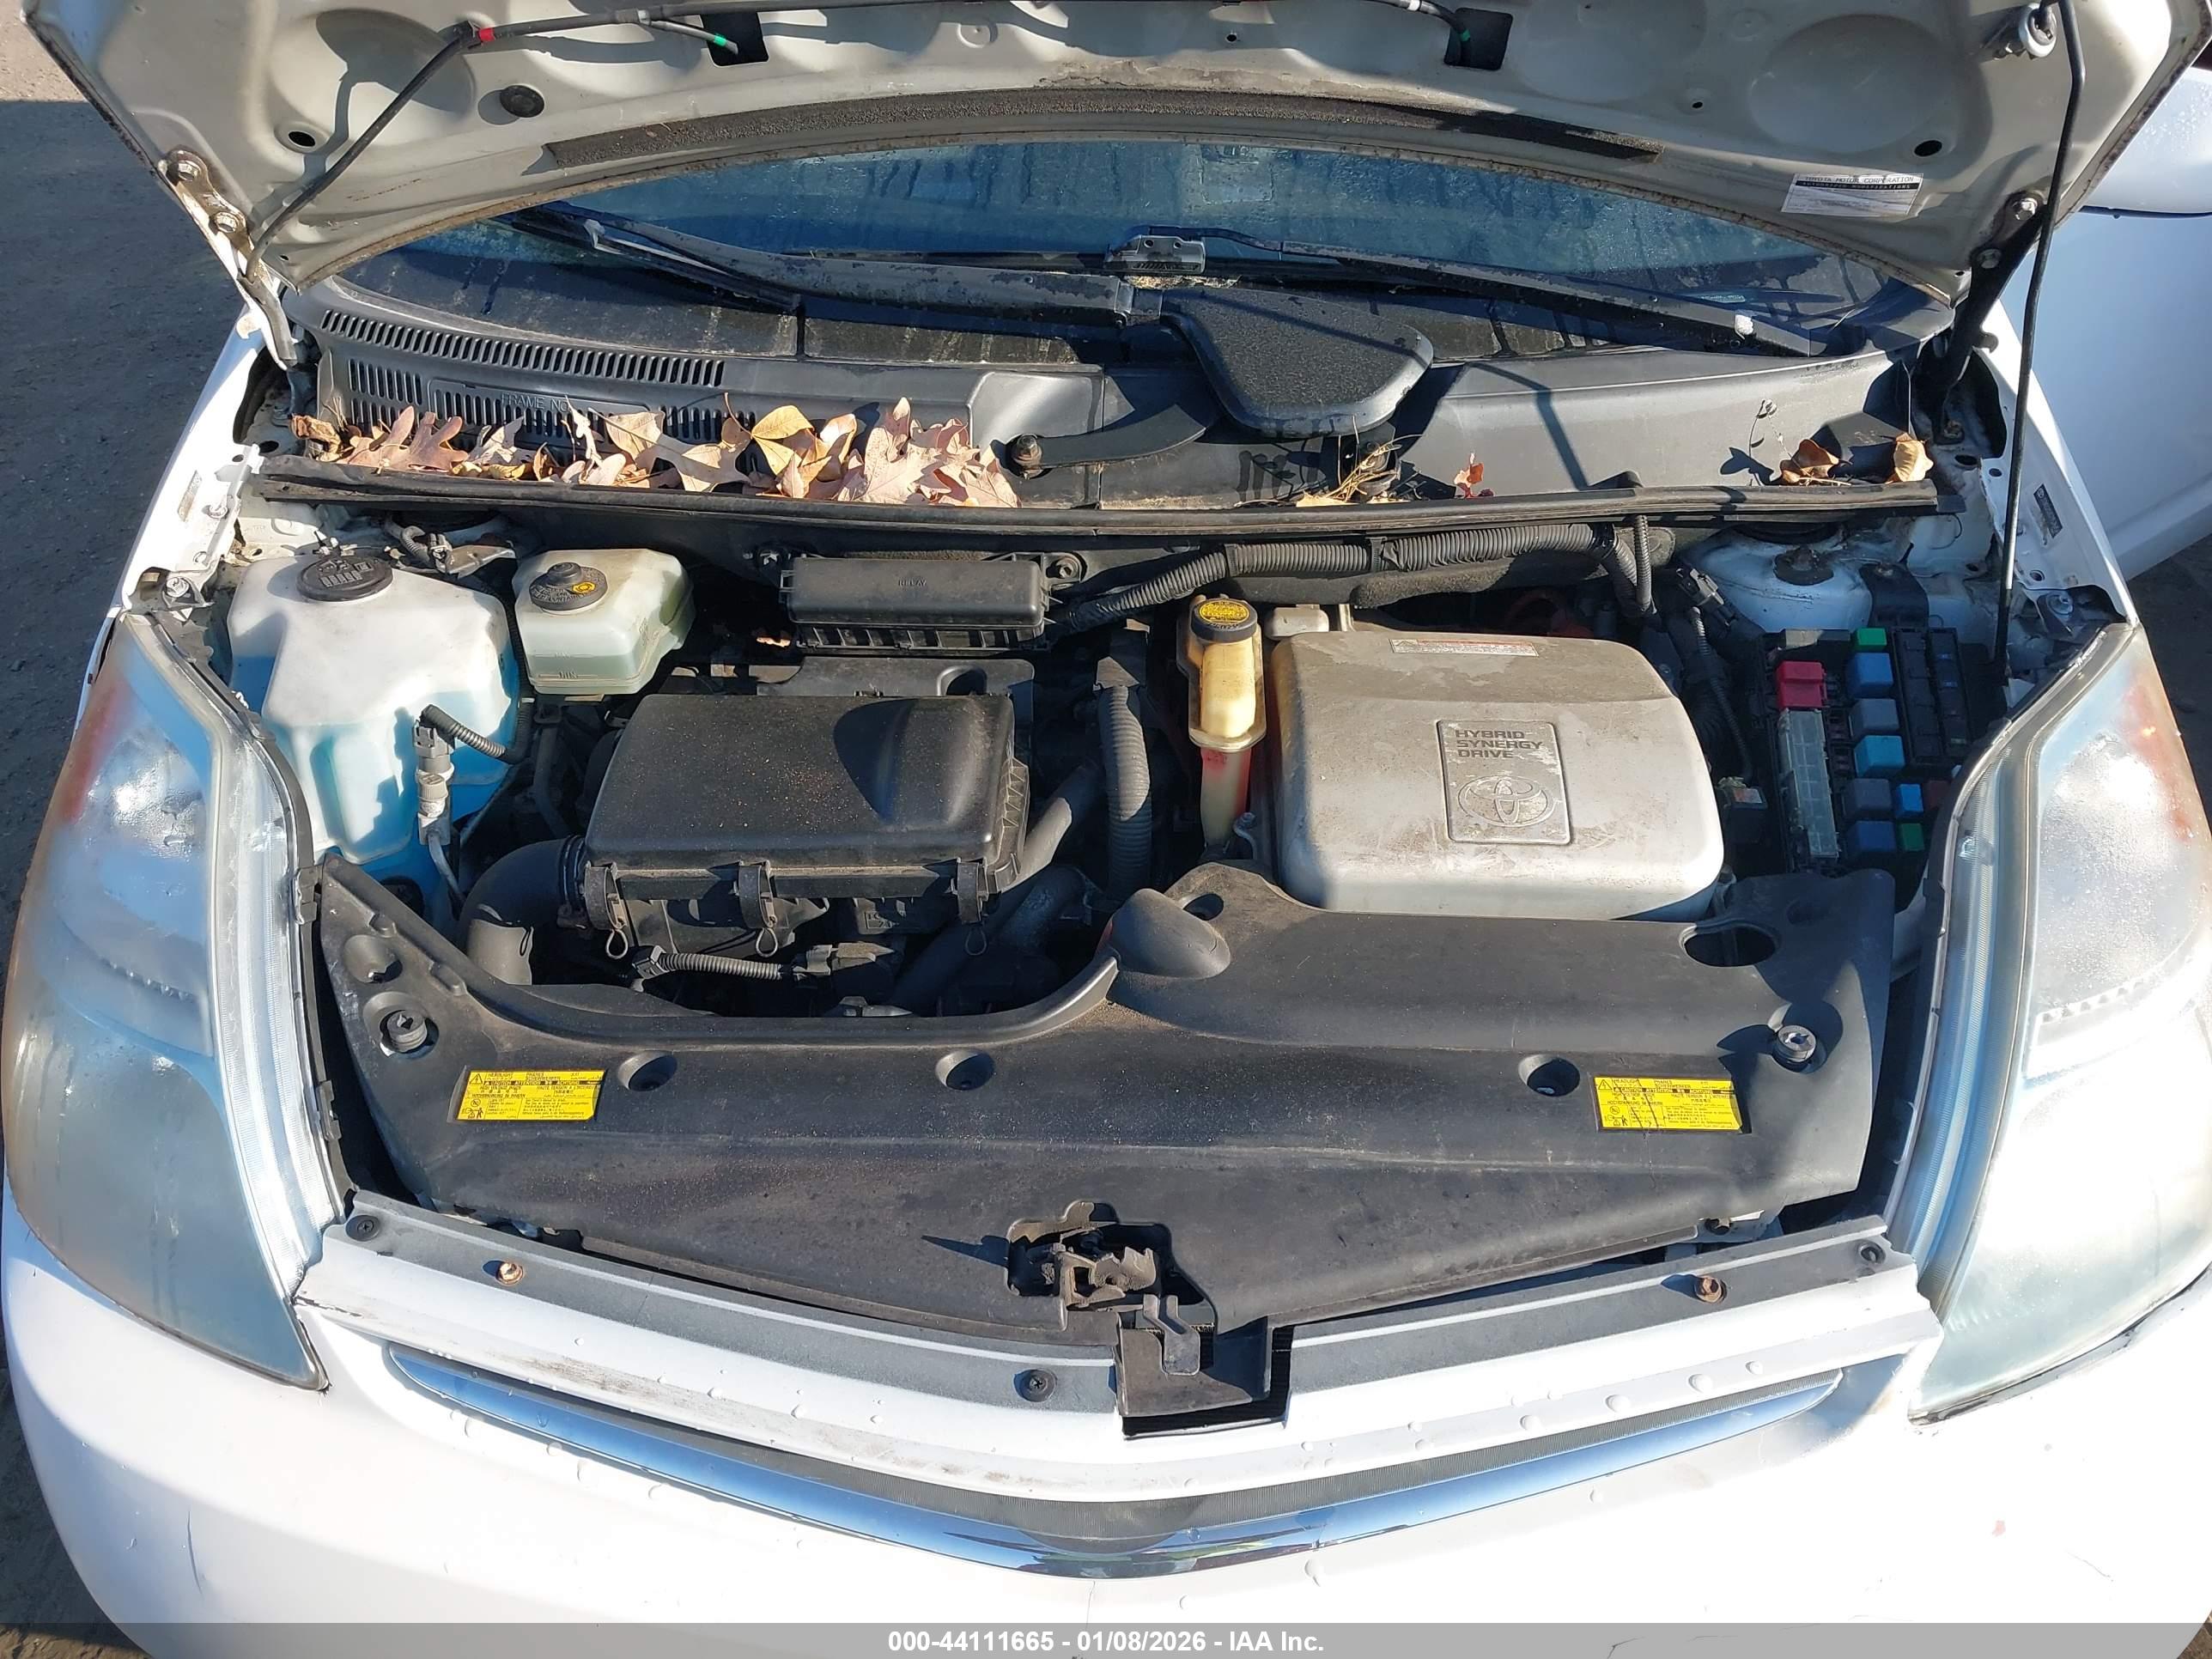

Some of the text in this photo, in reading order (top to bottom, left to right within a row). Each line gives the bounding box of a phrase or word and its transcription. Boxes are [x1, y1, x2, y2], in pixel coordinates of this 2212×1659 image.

[501, 393, 544, 410] FRAME
[1455, 729, 1525, 739] HYBRID
[1456, 739, 1543, 750] SYNERGY
[1458, 750, 1514, 758] DRIVE
